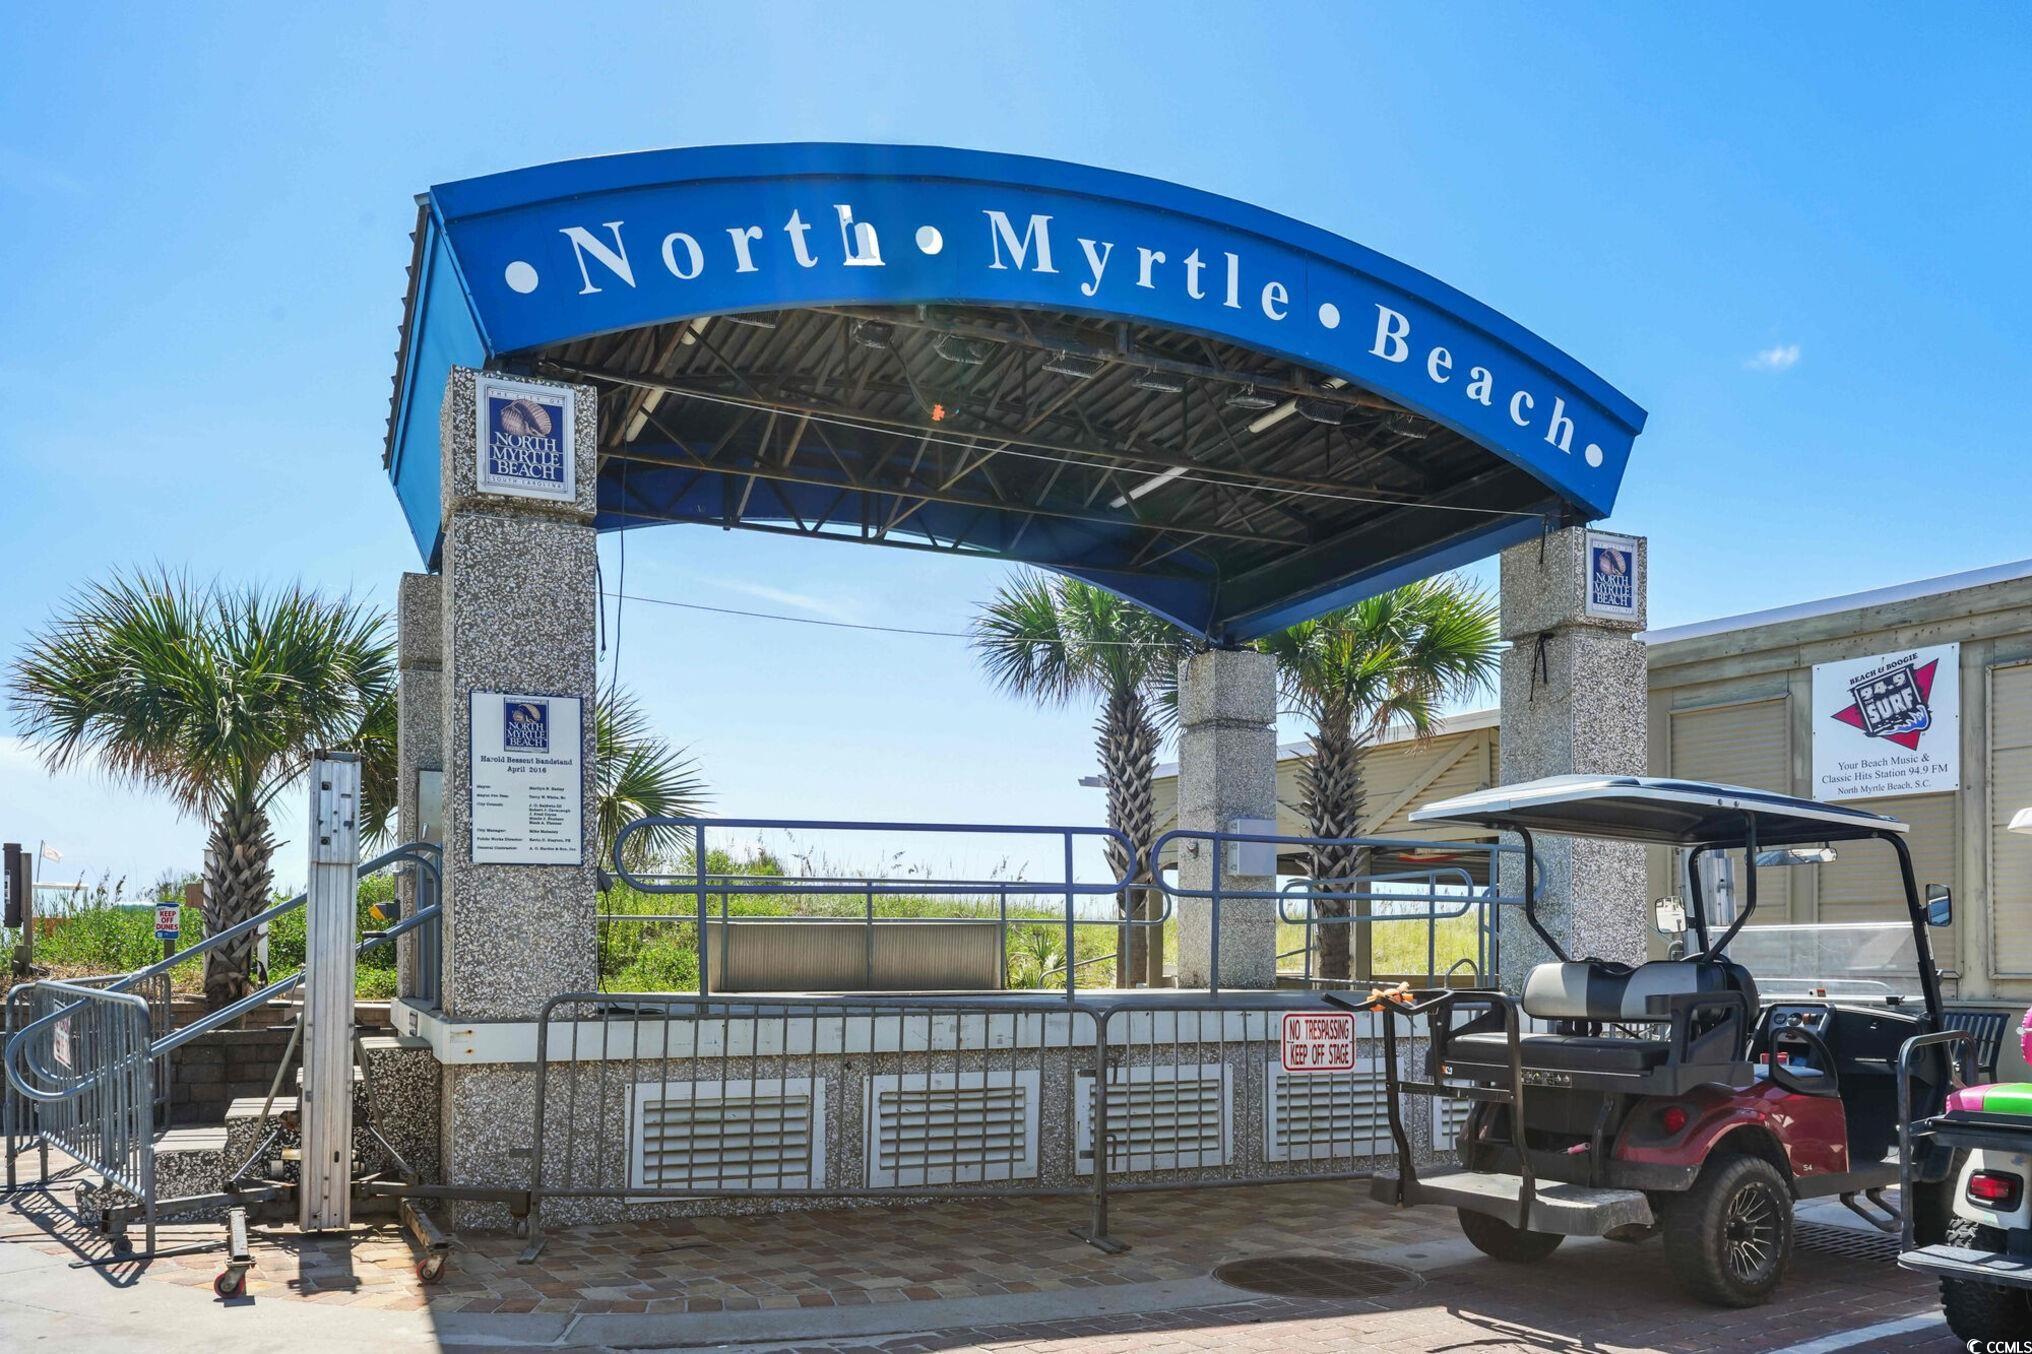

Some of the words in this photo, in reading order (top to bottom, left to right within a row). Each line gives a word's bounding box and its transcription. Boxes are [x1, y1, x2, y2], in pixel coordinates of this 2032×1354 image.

[559, 204, 886, 295] North
[982, 210, 1289, 321] Myrtle
[1368, 303, 1575, 455] Beach
[495, 432, 556, 452] NORTH
[493, 446, 561, 466] MYRTLE
[498, 460, 556, 480] BEACH
[1596, 572, 1629, 587] NORTH
[1594, 582, 1632, 597] MYRTLE
[1597, 593, 1628, 606] BEACH
[1849, 669, 1877, 685] BEACH
[1886, 652, 1919, 671] BOOGIE
[1860, 672, 1906, 700] 94.9
[1867, 688, 1914, 724] SURF
[507, 729, 546, 739] MYRTLE
[508, 721, 544, 731] NORTH
[510, 737, 543, 747] BEACH
[480, 755, 505, 763] Harold
[506, 756, 535, 764] Bessent
[535, 757, 573, 765] Bandstand
[507, 765, 526, 774] April
[1838, 761, 1859, 771] Your
[1861, 758, 1888, 769] Beach
[1891, 755, 1918, 766] Music
[1921, 753, 1930, 762] &
[1822, 773, 1852, 784] Classic
[1855, 770, 1872, 781] Hits
[1875, 768, 1906, 779] Station
[1909, 765, 1929, 775] 94.9
[1932, 764, 1948, 774] FM
[1838, 784, 1859, 795] North
[1860, 781, 1885, 794] Myrtle
[1289, 1020, 1301, 1040] NO
[1305, 1020, 1349, 1040] TRESPASSING
[1290, 1044, 1308, 1065] KEEP
[1311, 1044, 1325, 1065] OFF
[1329, 1044, 1349, 1064] STAGE
